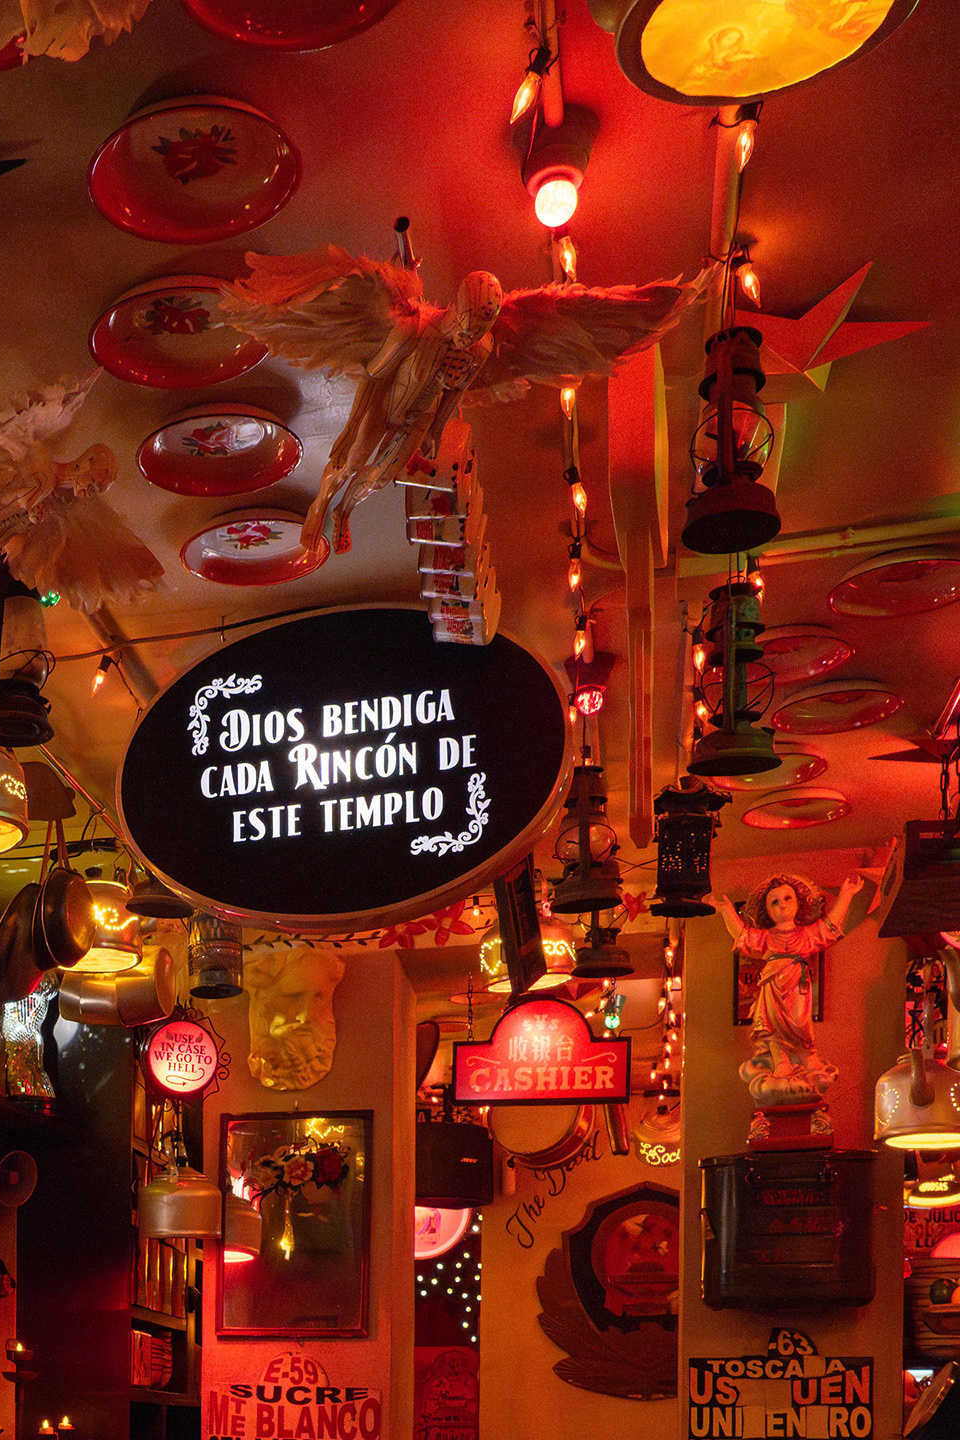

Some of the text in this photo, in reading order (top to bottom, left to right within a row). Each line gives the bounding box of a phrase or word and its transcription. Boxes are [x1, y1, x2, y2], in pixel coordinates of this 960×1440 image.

[219, 688, 456, 752] DIOS BENDIGA
[200, 732, 477, 799] CADA RINCÓN DE
[232, 786, 444, 842] ESTE TEMPLO
[160, 1042, 206, 1055] IN CASE
[173, 1034, 195, 1043] USE
[508, 1035, 575, 1063] 收银台
[153, 1050, 213, 1065] WE GO TO
[168, 1062, 197, 1073] HELL
[469, 1065, 615, 1092] CASHIER
[505, 1193, 545, 1249] The
[263, 1356, 318, 1385] E-59
[707, 1359, 846, 1379] TOSCAA
[230, 1384, 369, 1405] SUCRE
[689, 1366, 870, 1406] USUEN
[690, 1406, 872, 1438] UNIENRO
